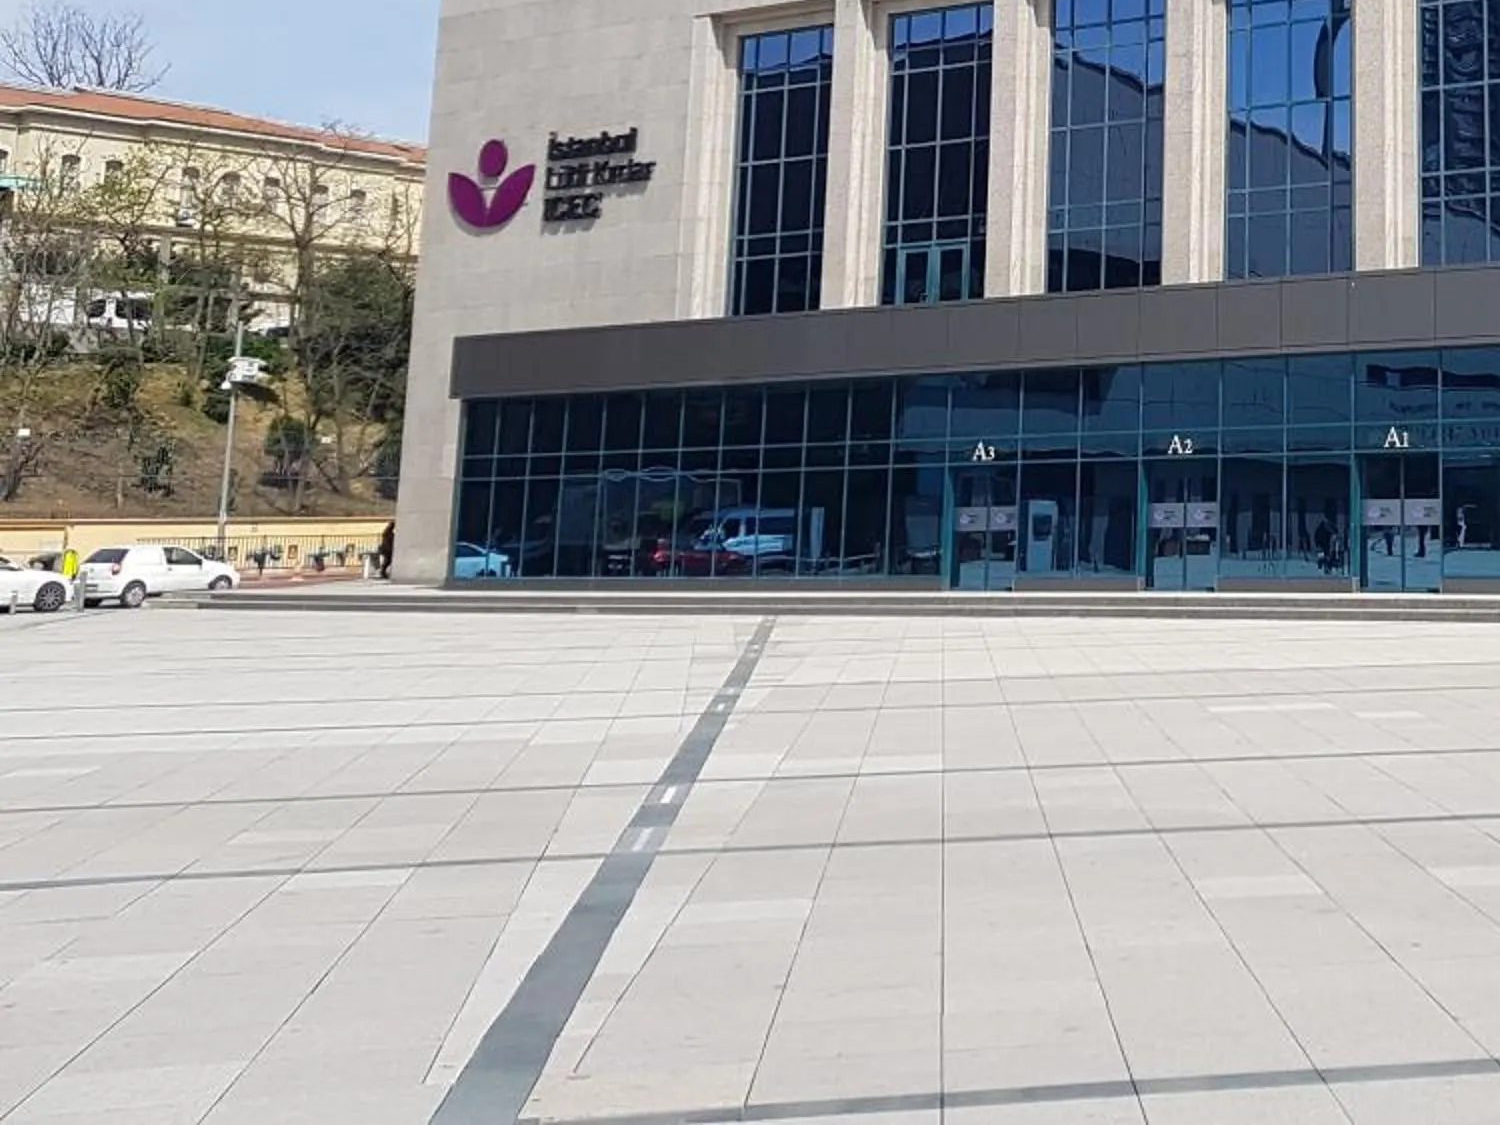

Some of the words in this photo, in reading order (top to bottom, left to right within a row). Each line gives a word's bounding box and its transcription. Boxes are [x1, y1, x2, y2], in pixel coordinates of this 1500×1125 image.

[1167, 434, 1193, 454] A2
[1384, 426, 1409, 447] A1
[972, 440, 995, 461] A3
